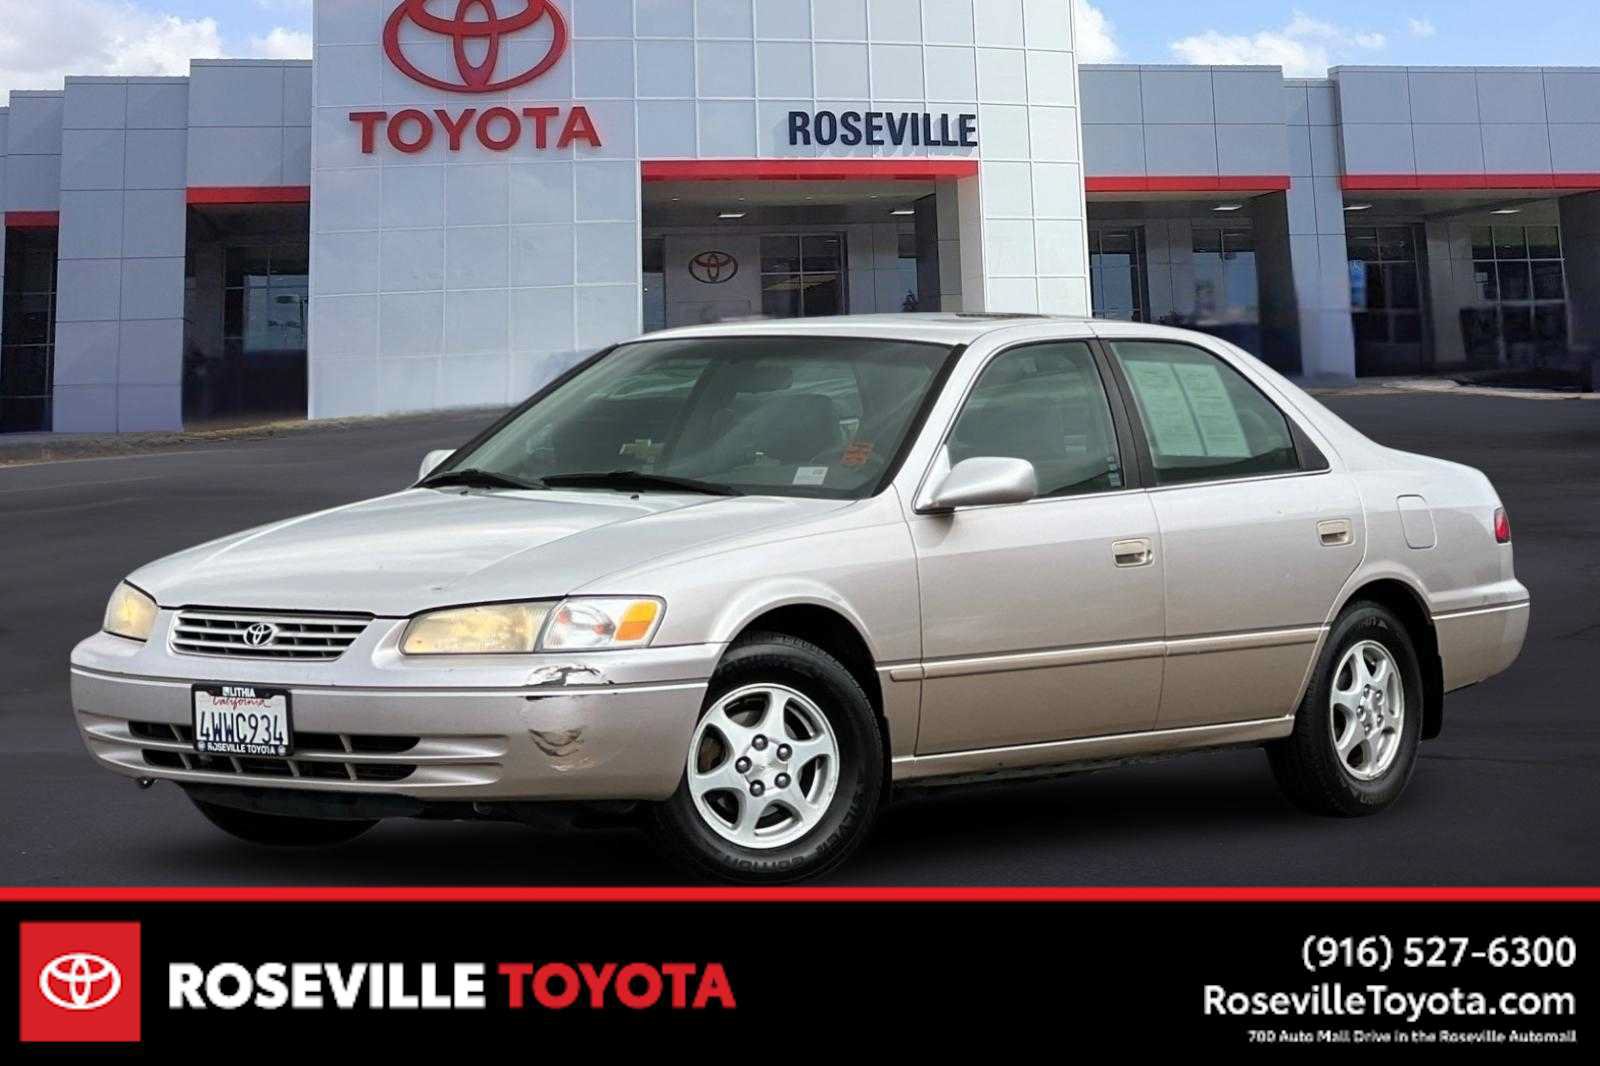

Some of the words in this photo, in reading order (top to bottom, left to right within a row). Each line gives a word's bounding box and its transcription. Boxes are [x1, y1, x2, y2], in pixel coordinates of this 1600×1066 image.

[349, 105, 603, 154] TOYOTA
[789, 111, 978, 147] ROSEVILLE
[212, 696, 271, 710] California
[229, 686, 256, 698] LITHIA
[200, 711, 284, 744] 4WWC934
[207, 743, 246, 753] ROSEVILLE
[247, 744, 276, 754] TOYOTA
